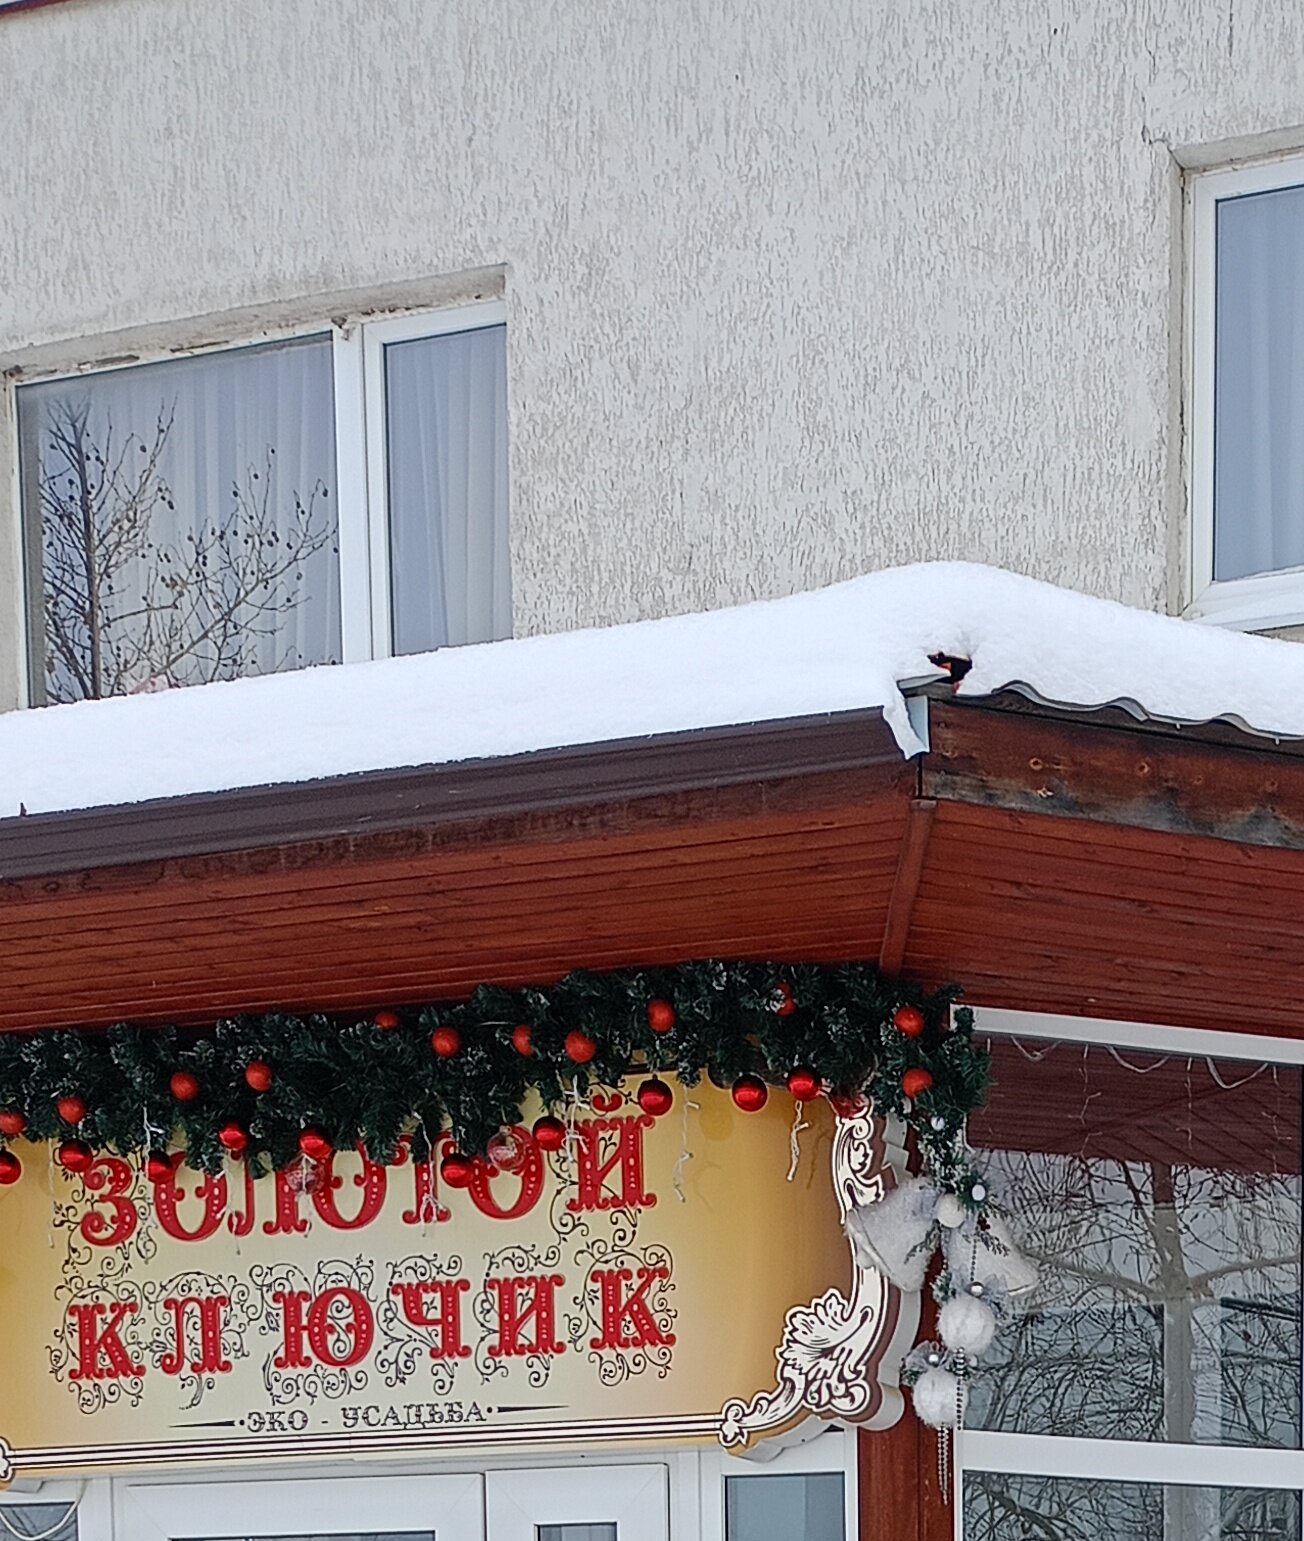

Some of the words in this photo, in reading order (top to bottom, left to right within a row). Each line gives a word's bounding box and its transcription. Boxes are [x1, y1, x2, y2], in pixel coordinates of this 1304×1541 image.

[80, 1092, 658, 1247] ЗОЛОТОЙ
[67, 1265, 677, 1381] КЛЮЧИК
[246, 1409, 310, 1433] ЭКО
[340, 1401, 487, 1431] УСАДЬБА
